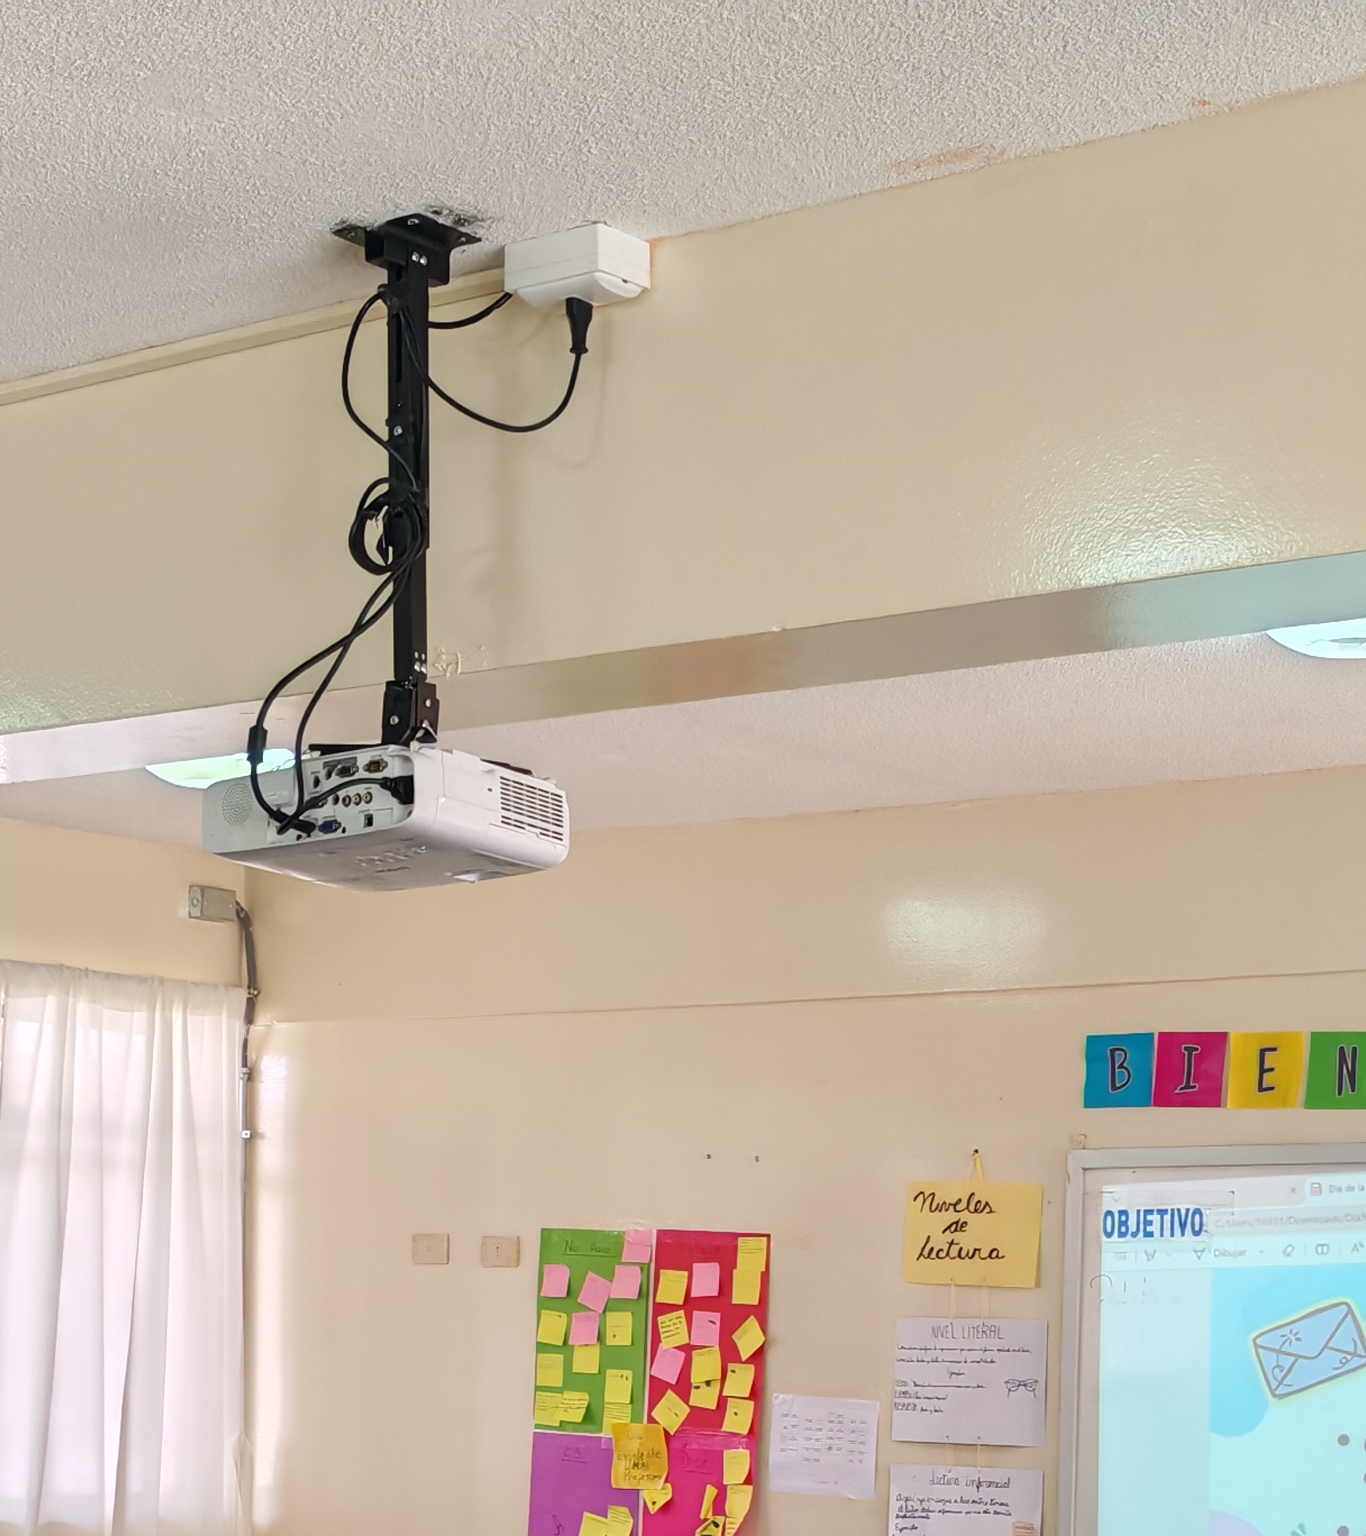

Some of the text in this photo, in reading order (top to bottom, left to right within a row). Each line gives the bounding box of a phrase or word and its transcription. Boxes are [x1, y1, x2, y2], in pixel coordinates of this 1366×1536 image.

[913, 1190, 996, 1214] Niveles
[942, 1217, 968, 1234] de
[1102, 1206, 1204, 1240] OBJETIVO
[916, 1235, 1005, 1262] Lectura
